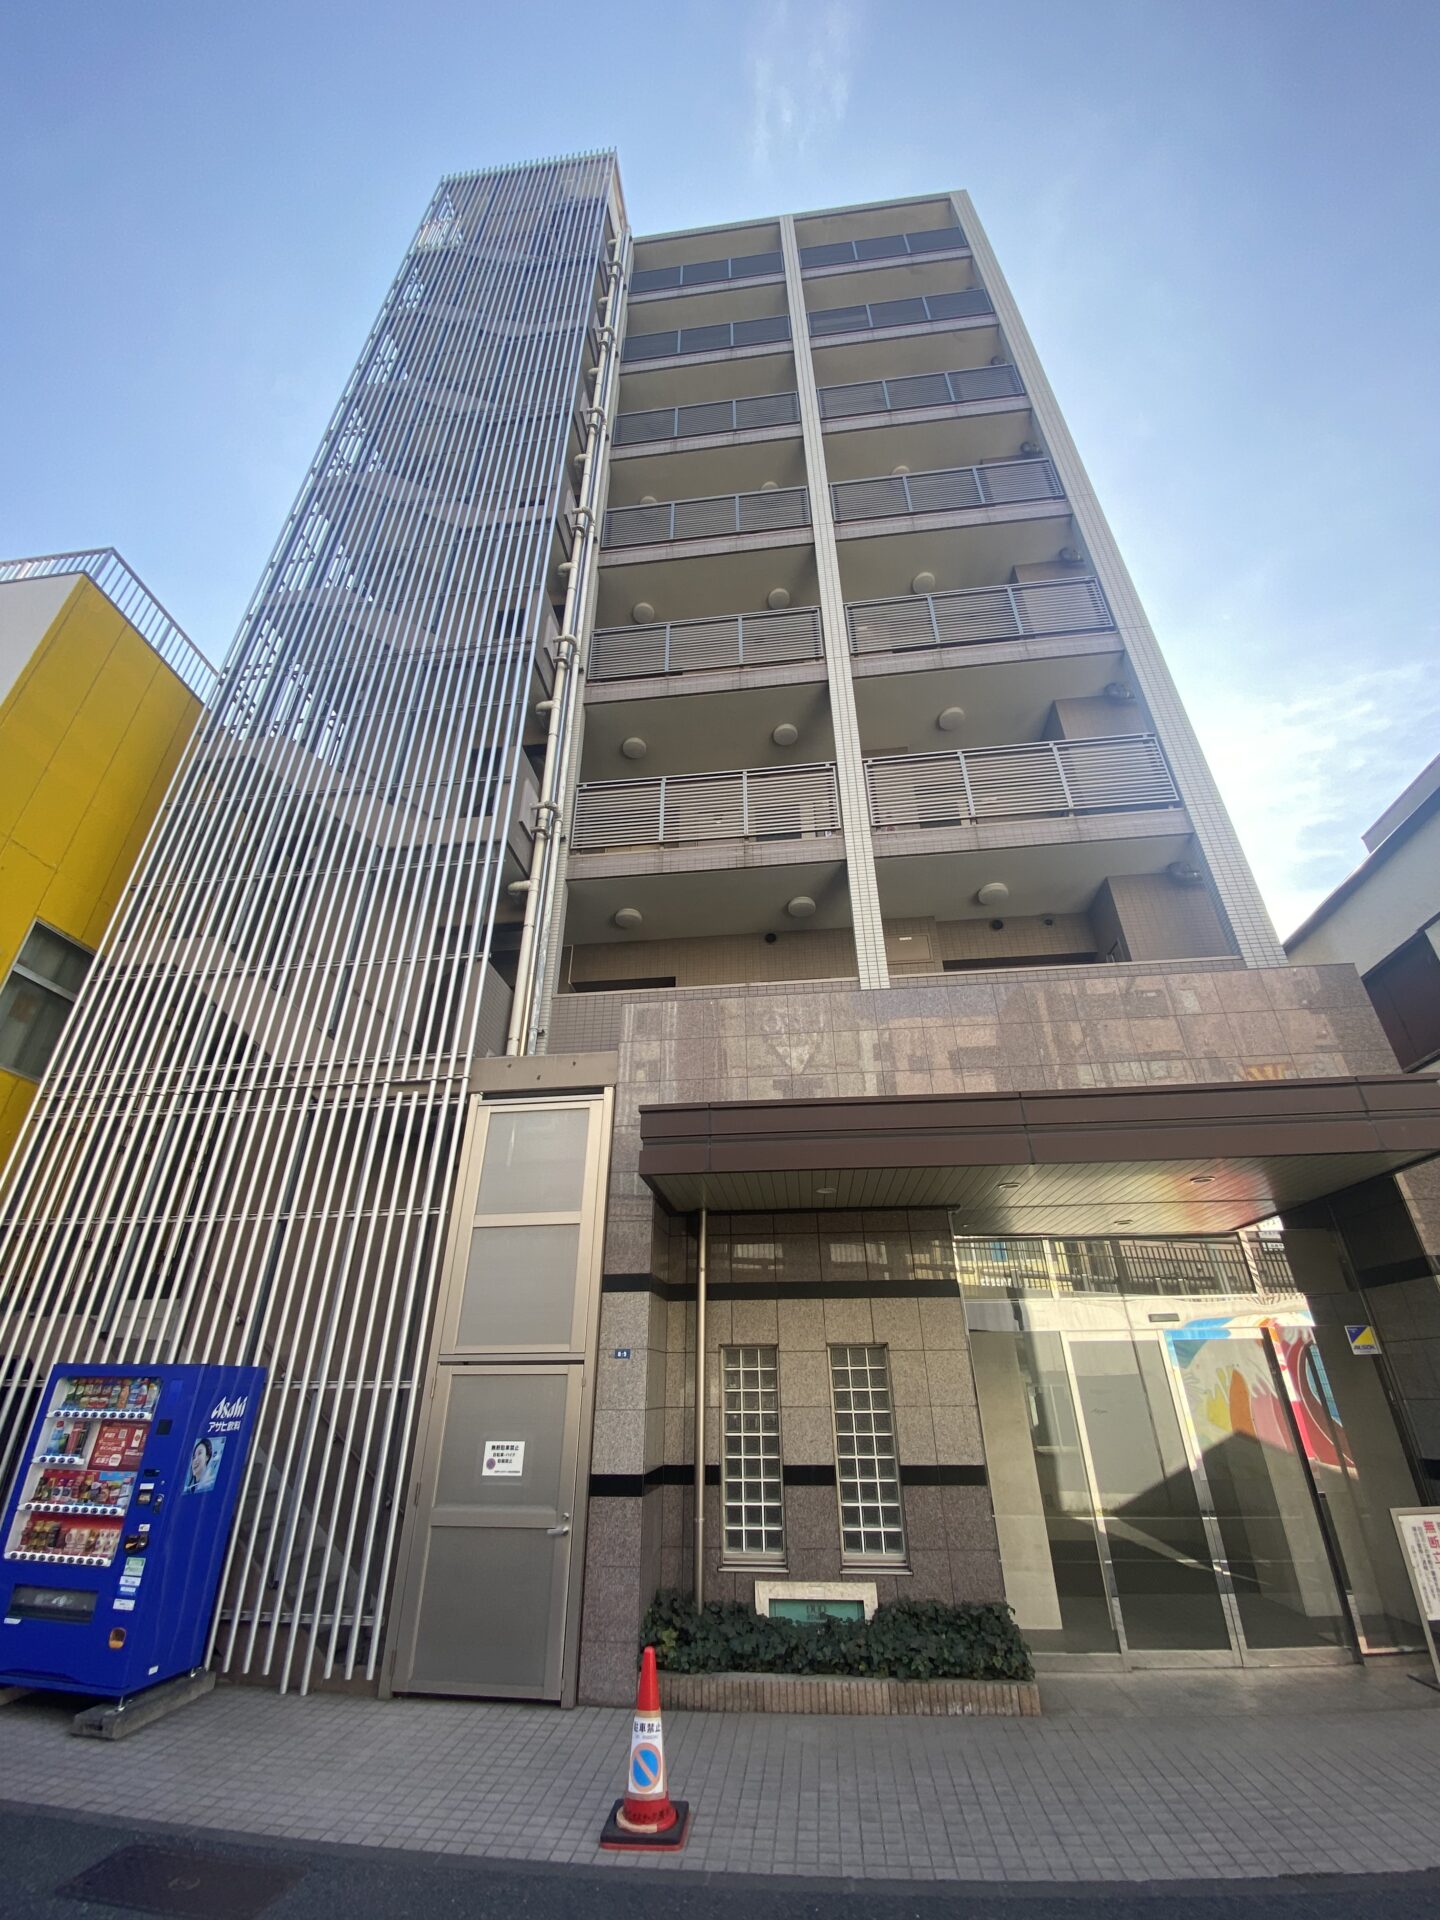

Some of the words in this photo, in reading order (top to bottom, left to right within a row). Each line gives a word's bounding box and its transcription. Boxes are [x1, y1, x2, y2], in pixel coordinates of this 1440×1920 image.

[210, 1395, 248, 1419] Asahi
[207, 1420, 241, 1433] アサヒ飲料
